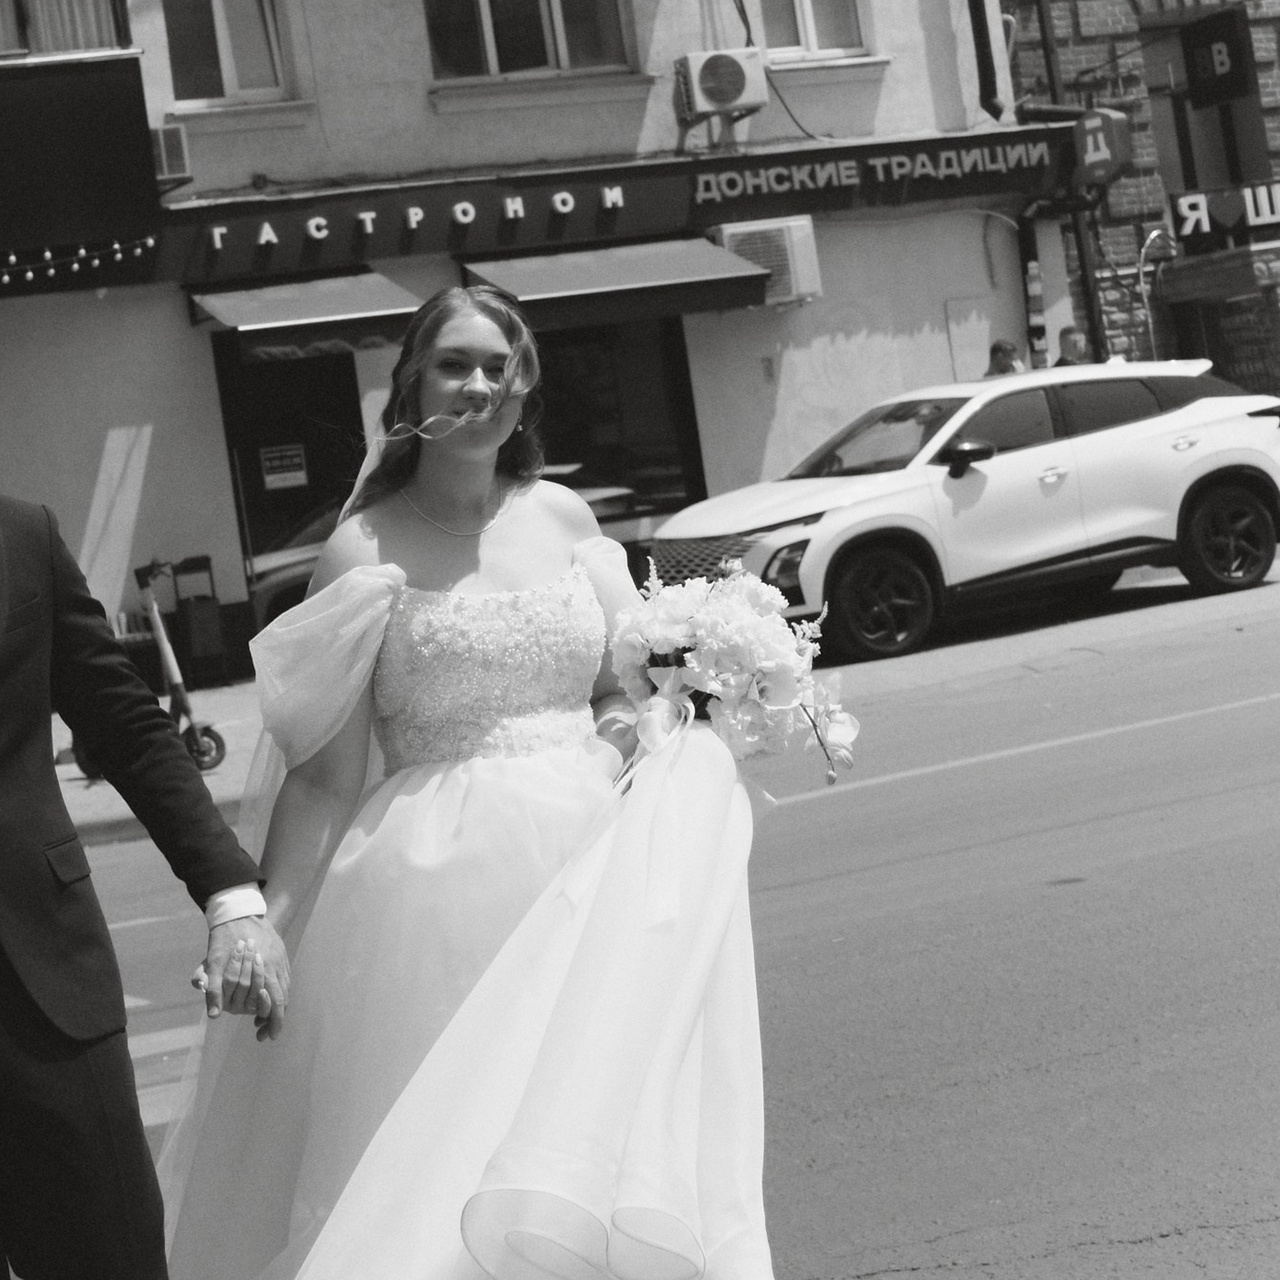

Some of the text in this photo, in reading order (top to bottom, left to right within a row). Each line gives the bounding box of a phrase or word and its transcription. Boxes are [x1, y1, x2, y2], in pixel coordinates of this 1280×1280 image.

[696, 142, 1051, 203] ДОНСКИЕ ТРАДИЦИИ
[211, 186, 625, 250] ГАСТРОНОМ
[1178, 193, 1211, 236] Я
